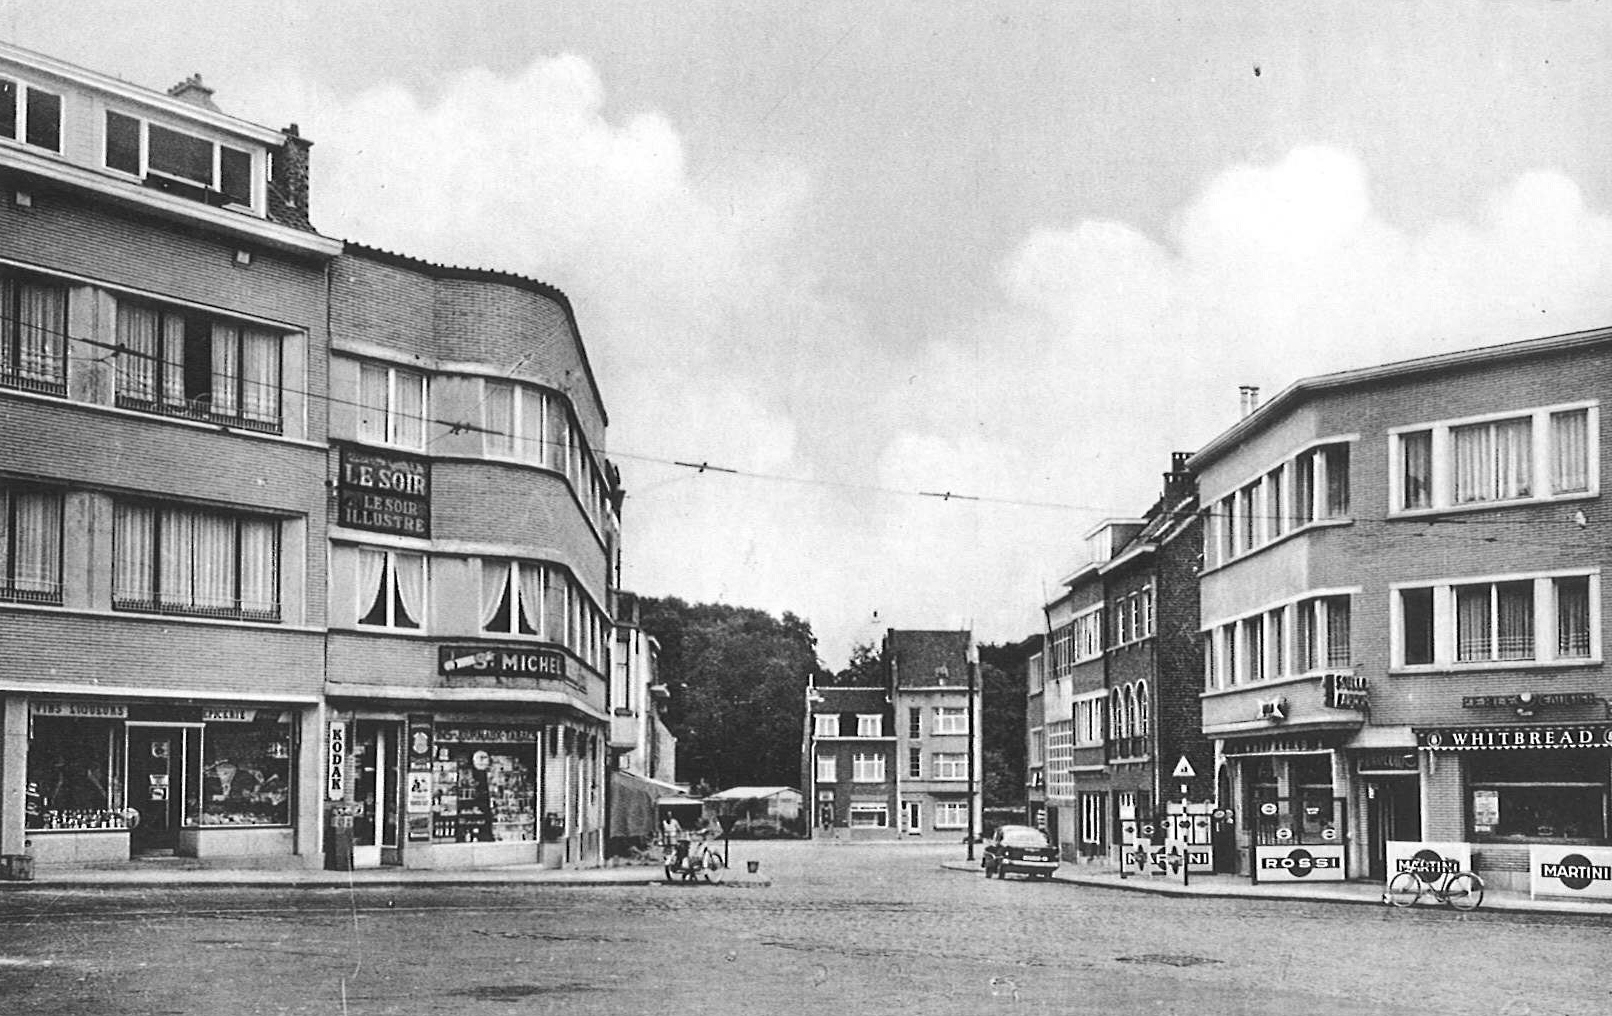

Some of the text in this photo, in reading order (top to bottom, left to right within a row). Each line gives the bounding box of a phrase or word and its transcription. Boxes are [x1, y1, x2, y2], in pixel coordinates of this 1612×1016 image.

[345, 463, 425, 496] LE SOIR
[364, 495, 417, 516] LE SOIR
[346, 508, 425, 532] ILLUSTRE
[502, 653, 561, 675] MICHEL
[1452, 731, 1593, 745] WHITBREAD
[332, 729, 342, 790] KODAK
[1265, 858, 1336, 868] ROSSI
[1544, 864, 1608, 879] MARTINI
